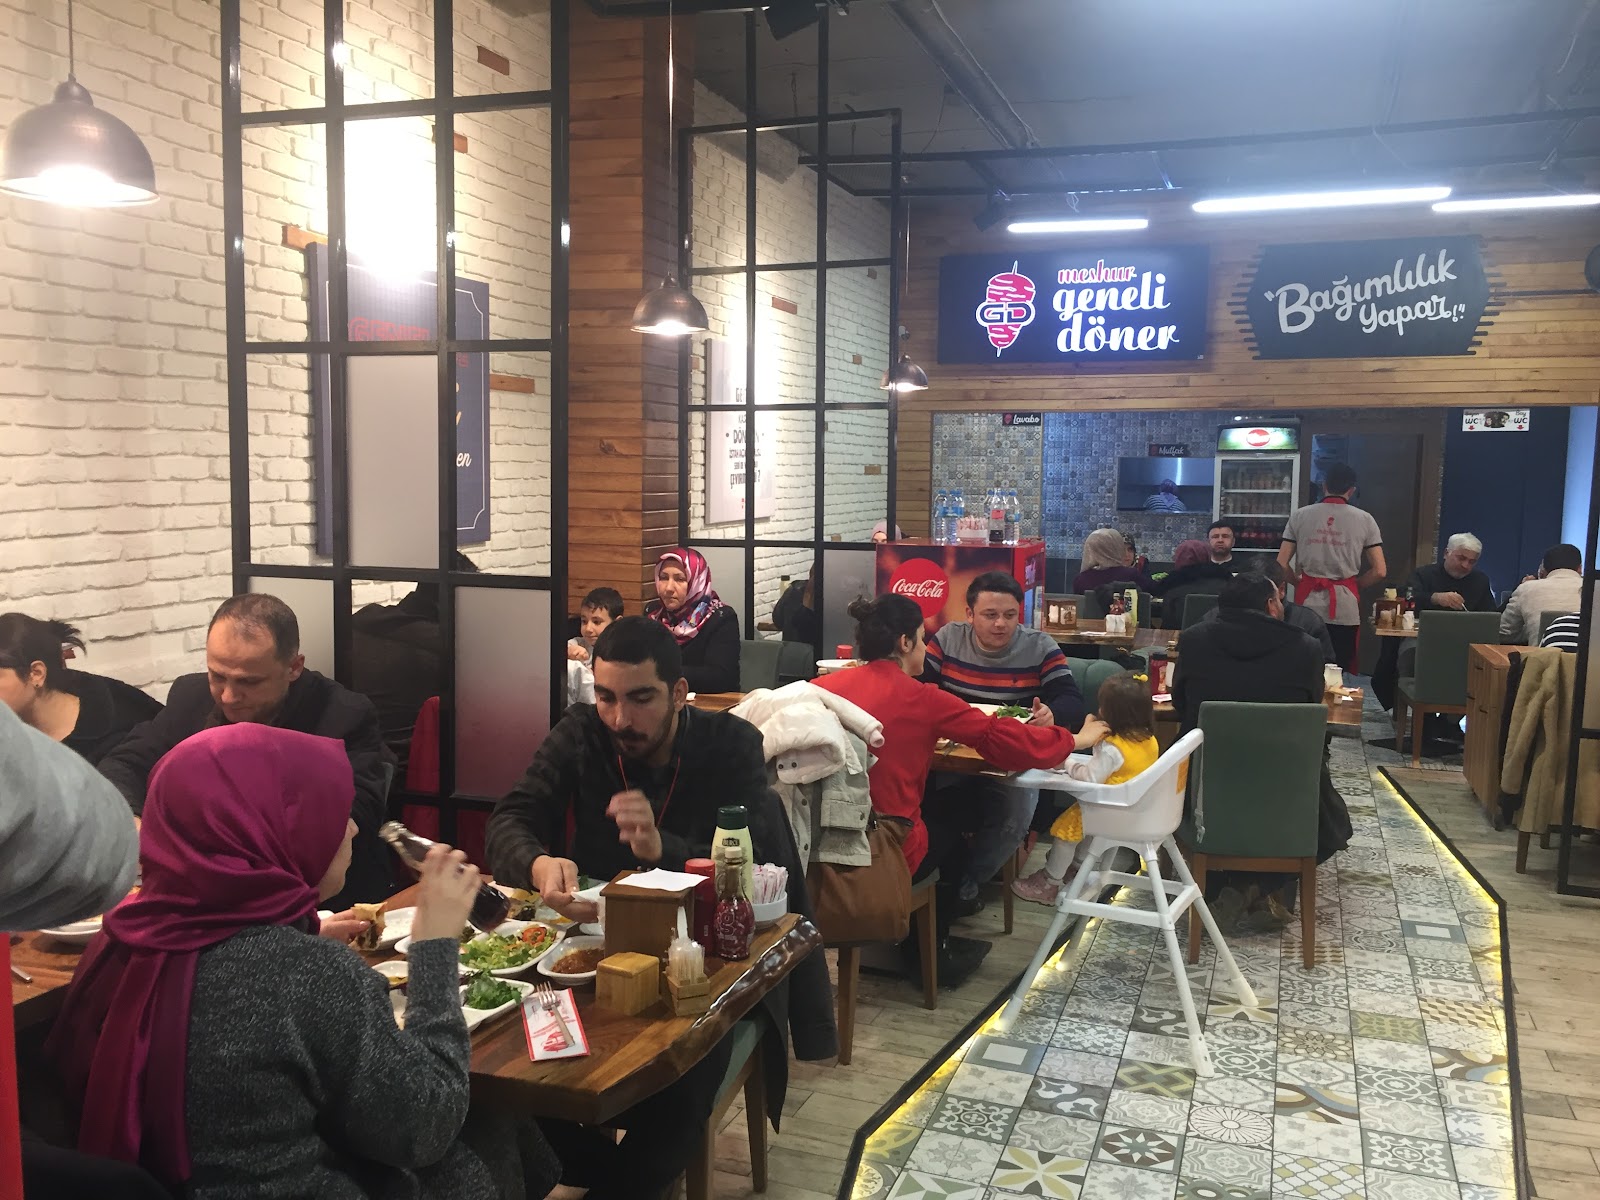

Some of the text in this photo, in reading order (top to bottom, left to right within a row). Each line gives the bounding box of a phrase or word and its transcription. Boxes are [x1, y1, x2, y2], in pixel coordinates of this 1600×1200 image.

[1052, 271, 1172, 322] geneli
[1056, 312, 1180, 352] döner
[1012, 414, 1041, 425] Lavabo
[1464, 417, 1479, 425] WC
[1513, 416, 1528, 424] WC
[1158, 446, 1185, 456] Mutfak
[892, 578, 947, 598] Coca-Cola
